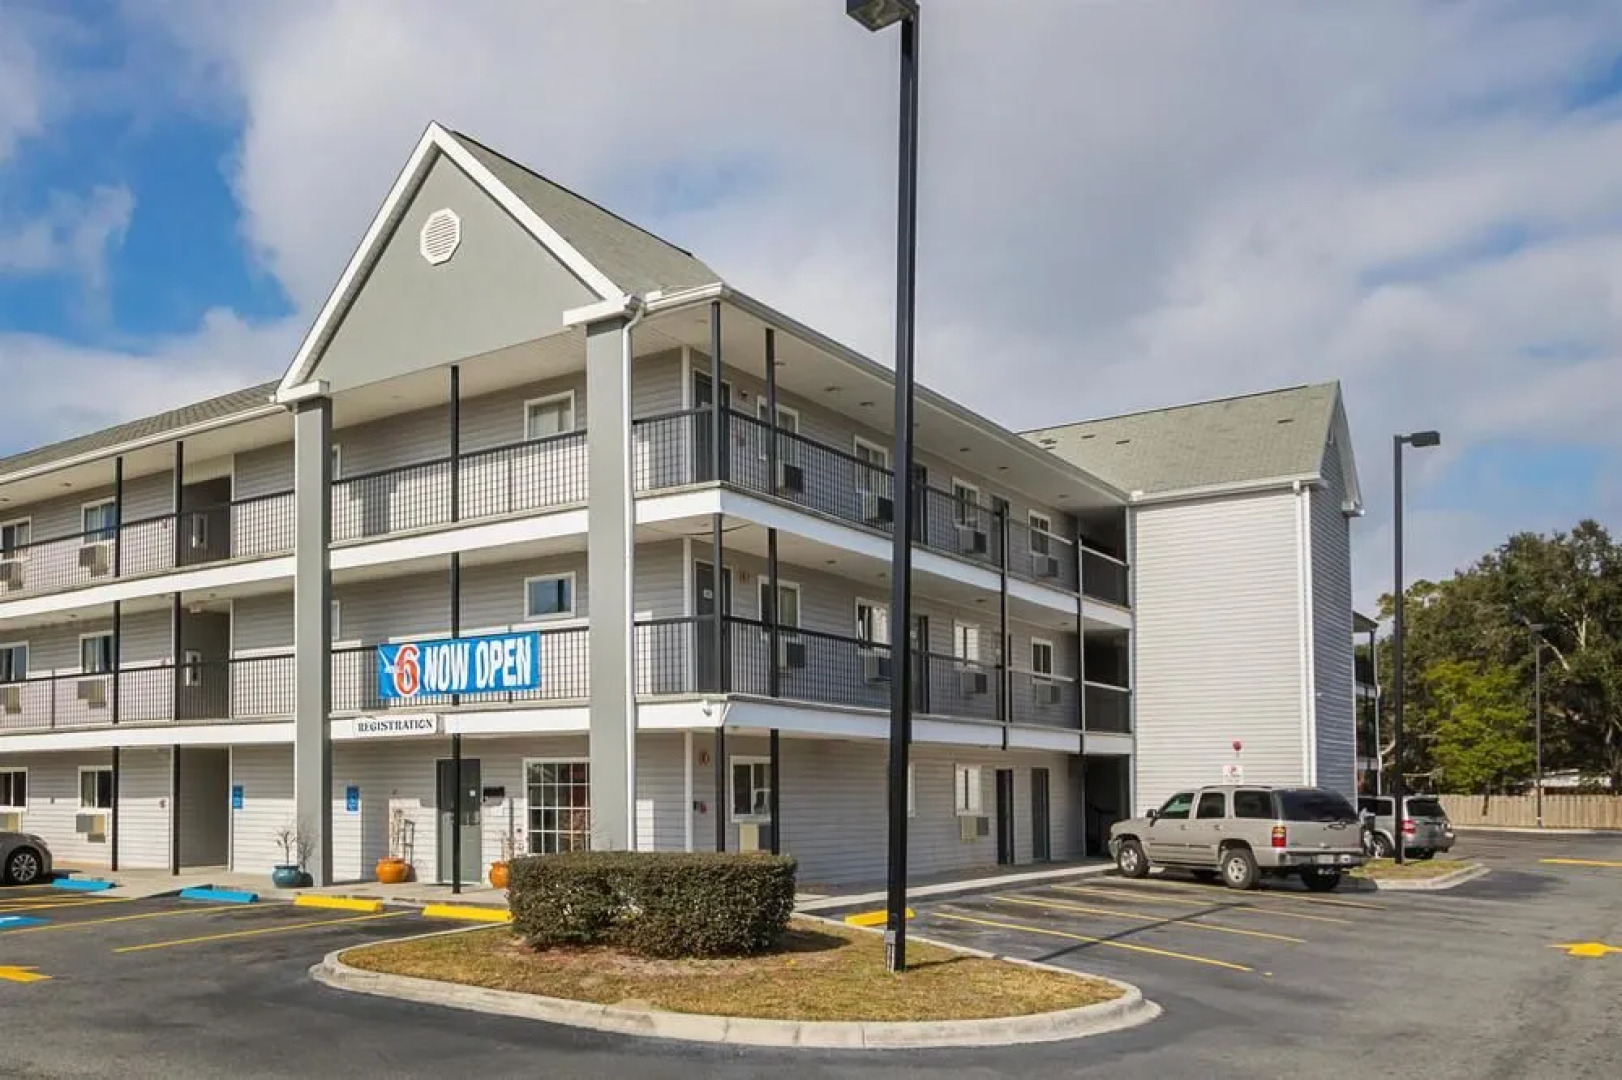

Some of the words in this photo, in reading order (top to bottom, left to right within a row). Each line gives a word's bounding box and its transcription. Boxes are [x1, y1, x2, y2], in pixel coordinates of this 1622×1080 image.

[395, 644, 420, 697] 6
[425, 643, 470, 691] NOW
[477, 636, 531, 689] OPEN
[357, 718, 433, 732] REGISTRATION
